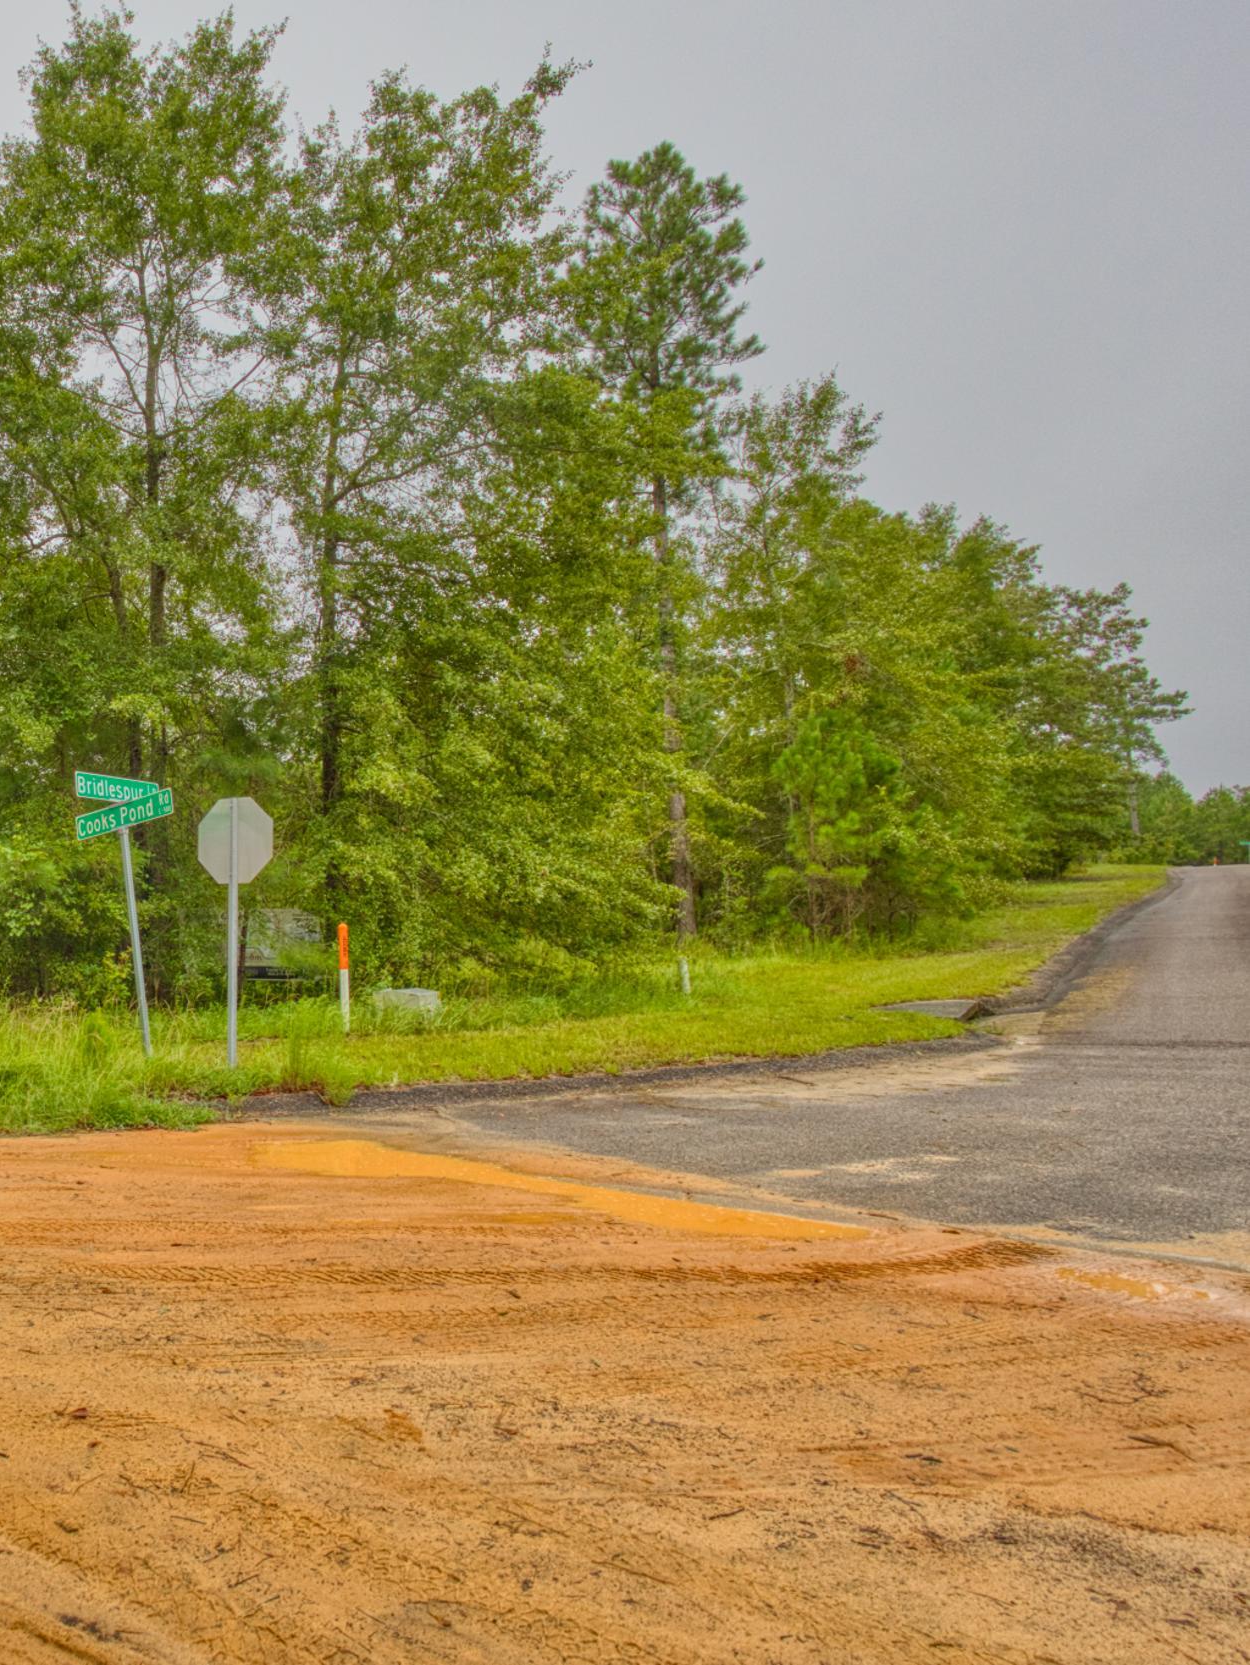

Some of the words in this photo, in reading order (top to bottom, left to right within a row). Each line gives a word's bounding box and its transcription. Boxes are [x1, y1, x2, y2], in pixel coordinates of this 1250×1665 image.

[77, 776, 144, 800] Bridlespur
[78, 814, 116, 837] Cooks
[120, 798, 154, 825] Pond
[158, 792, 169, 806] Rd
